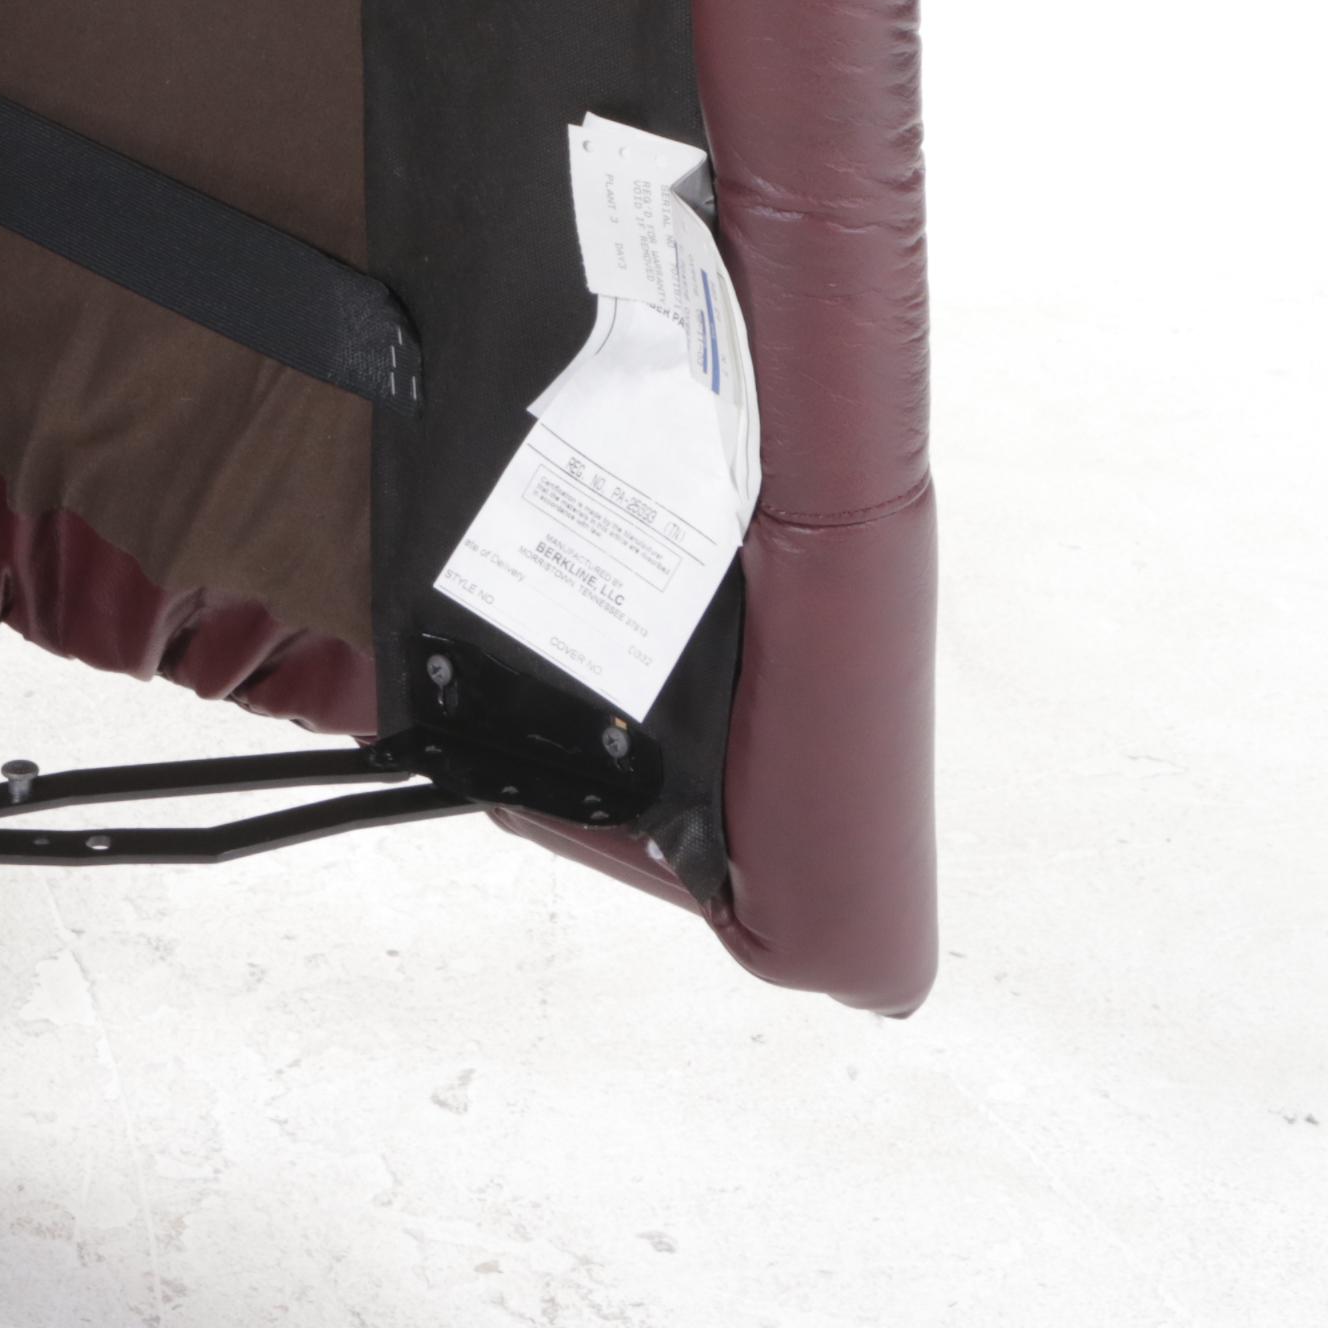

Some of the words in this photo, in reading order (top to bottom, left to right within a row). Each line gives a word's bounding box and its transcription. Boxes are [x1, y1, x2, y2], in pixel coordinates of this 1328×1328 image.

[604, 173, 617, 210] PLANT
[639, 235, 653, 282] REMOVED
[651, 249, 665, 304] WARRANTY
[565, 456, 589, 479] REG.
[488, 552, 528, 584] Delivery
[533, 540, 601, 590] BERKLINE,
[598, 583, 626, 606] LLC
[544, 533, 613, 582] MANUFACTURED
[445, 568, 477, 594] STYLE
[575, 583, 627, 621] TENNESSEE
[547, 634, 587, 665] COVER
